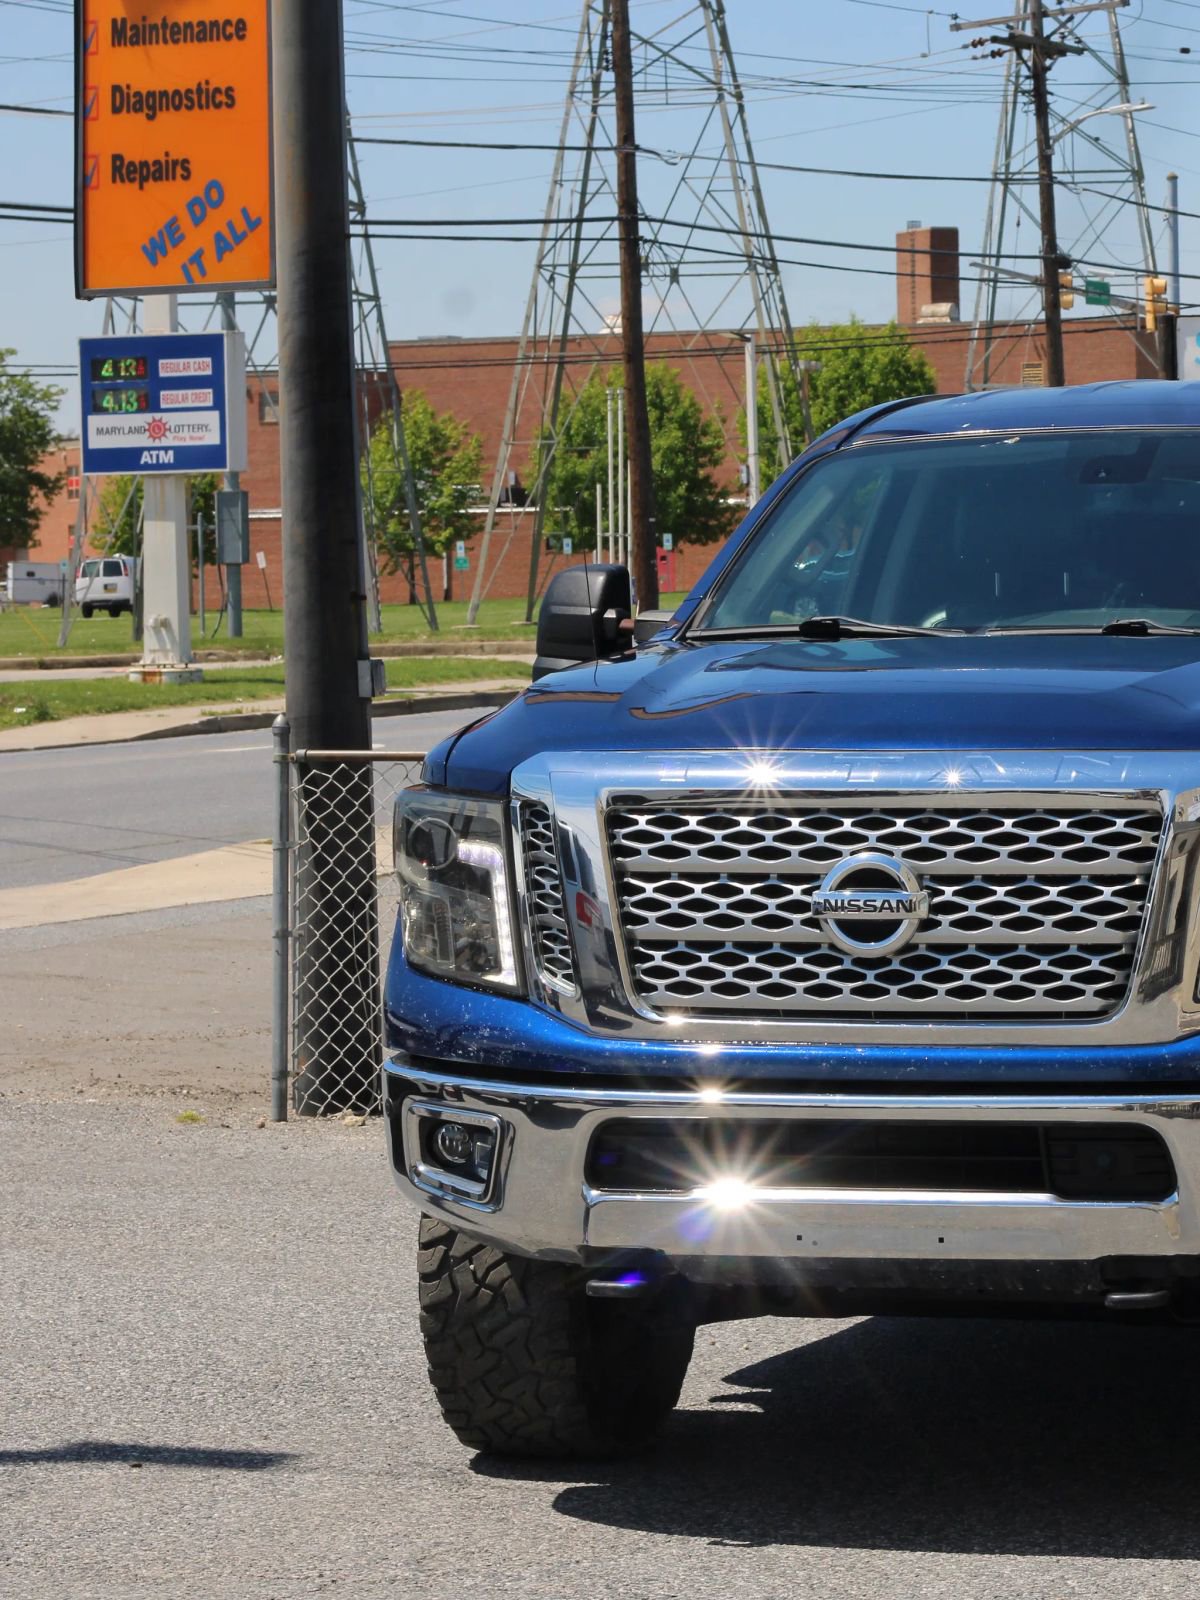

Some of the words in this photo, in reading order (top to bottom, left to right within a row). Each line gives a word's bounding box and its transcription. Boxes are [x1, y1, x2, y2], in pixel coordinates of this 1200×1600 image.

[111, 16, 247, 48] Maintenance
[111, 80, 236, 121] Diagnostics
[111, 152, 191, 190] Repairs
[141, 216, 186, 267] WE
[186, 179, 225, 228] DO
[181, 248, 207, 284] IT
[213, 207, 262, 262] ALL
[160, 361, 191, 373] REGULAR
[193, 360, 210, 372] CASH
[162, 392, 189, 405] REGULAR
[96, 425, 146, 436] MARYLAND
[169, 424, 209, 434] LOTTERY
[140, 450, 174, 465] ATM
[823, 898, 914, 914] NISSAN
